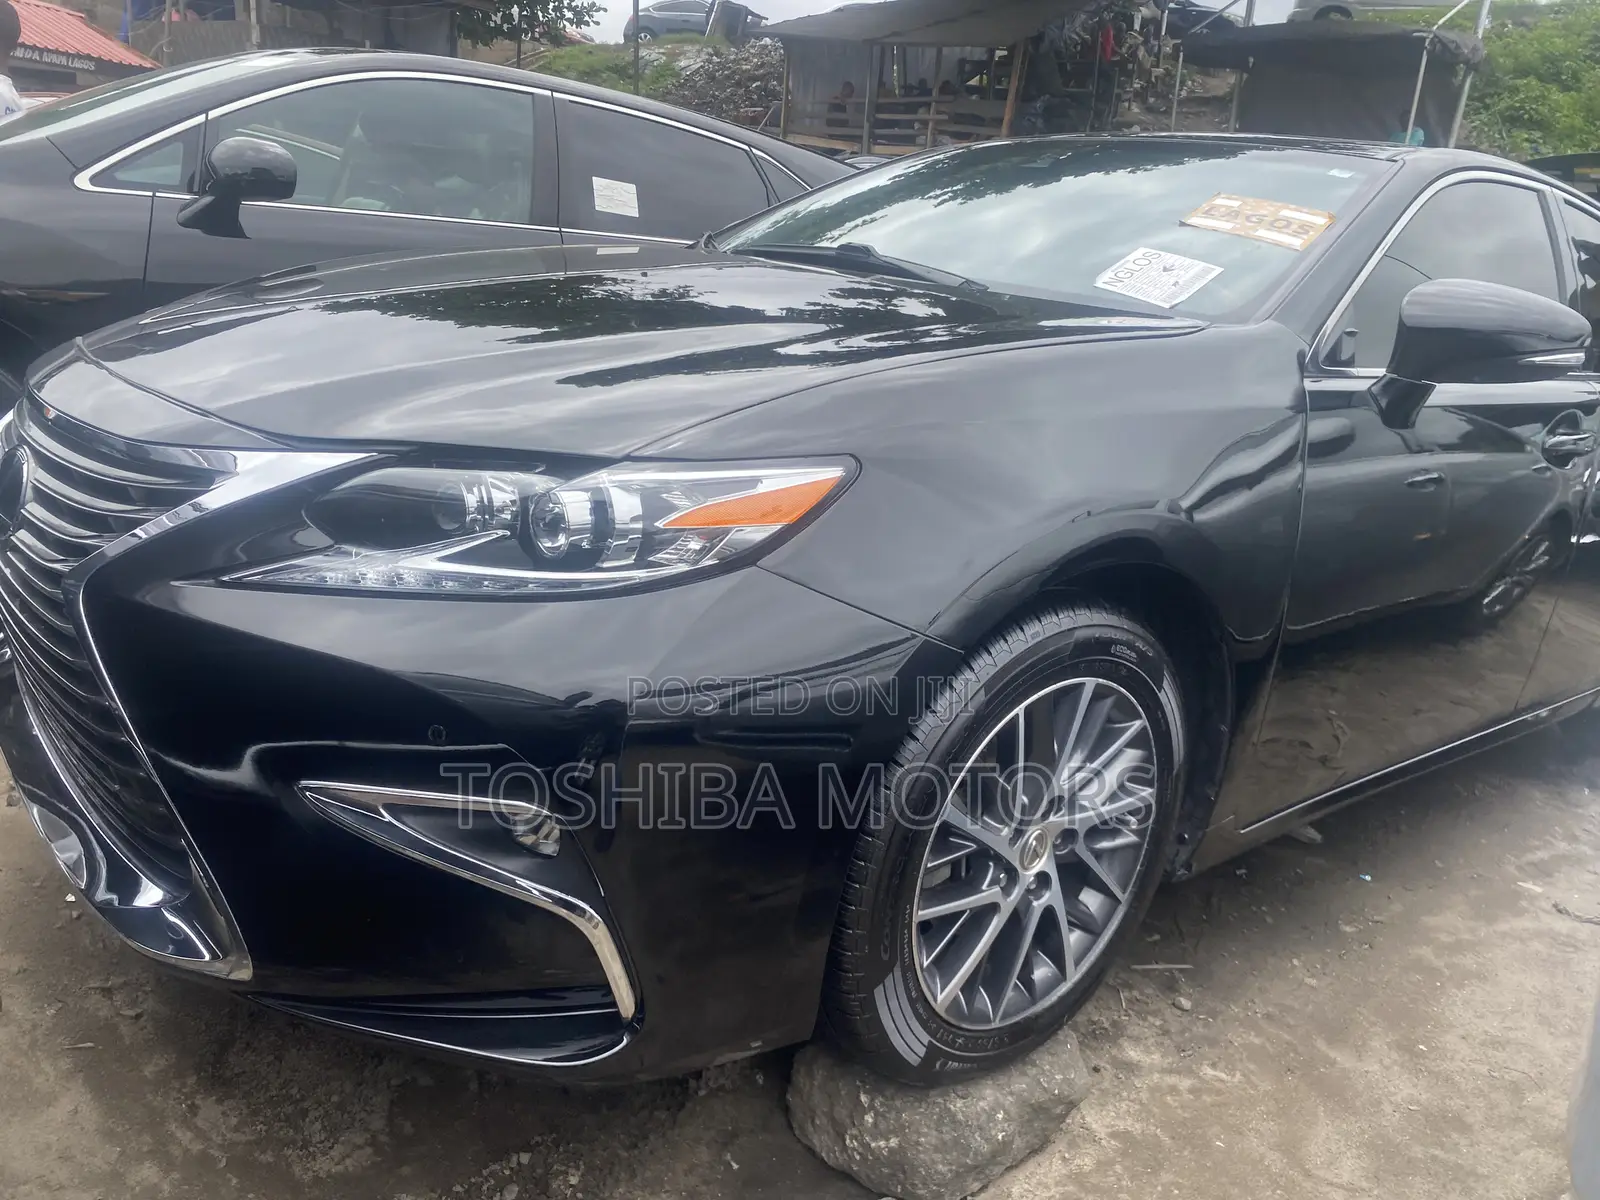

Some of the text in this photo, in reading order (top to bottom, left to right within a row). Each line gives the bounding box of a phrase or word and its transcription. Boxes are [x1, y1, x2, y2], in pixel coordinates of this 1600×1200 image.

[68, 55, 96, 71] LAGOS
[1202, 206, 1316, 236] LAGOS
[1102, 250, 1162, 288] NGLOS
